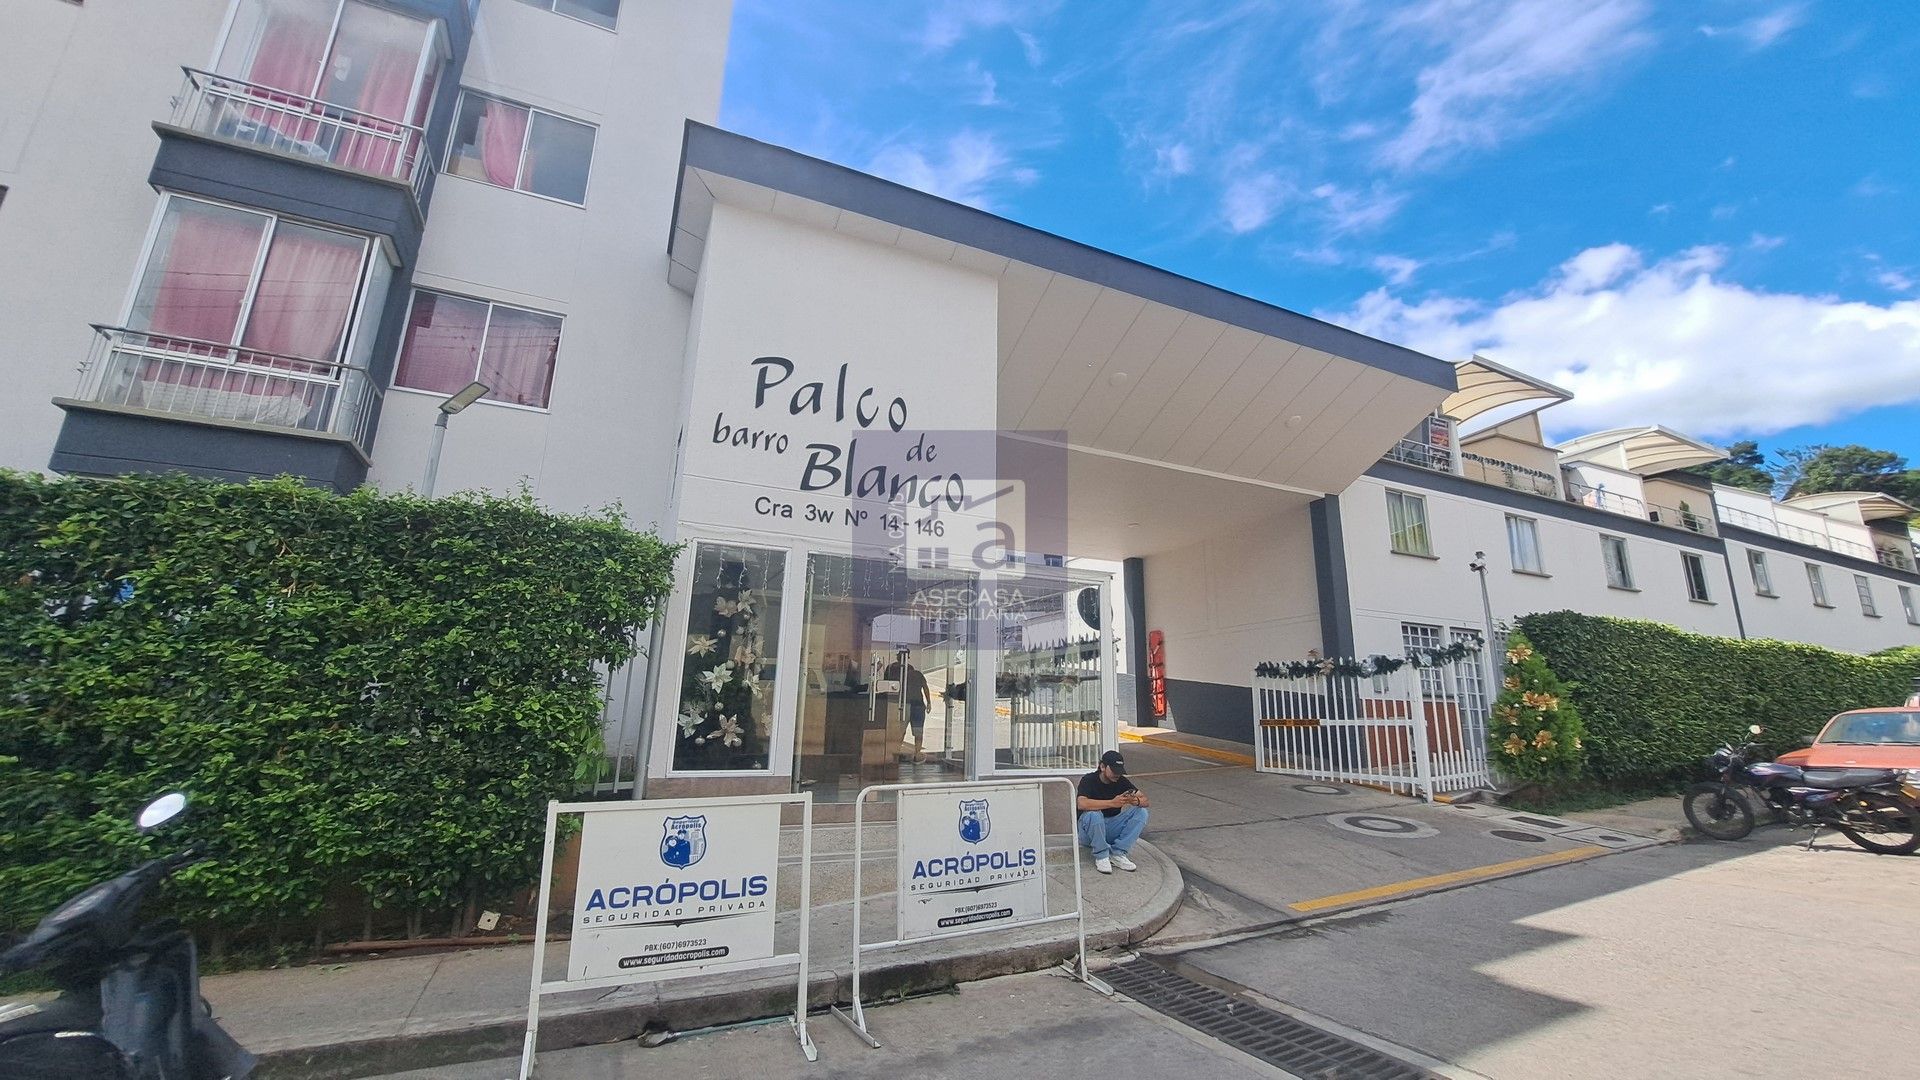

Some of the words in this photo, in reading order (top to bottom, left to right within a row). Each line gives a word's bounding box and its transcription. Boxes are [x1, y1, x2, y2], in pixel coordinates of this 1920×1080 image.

[751, 356, 907, 433] Palco
[712, 412, 789, 454] barro
[906, 433, 937, 463] de
[799, 439, 964, 512] Blanco
[754, 496, 793, 519] Cra
[804, 503, 833, 524] 3w
[912, 849, 1036, 879] ACRÓPOLIS
[585, 875, 768, 911] ACRÓPOLIS
[911, 877, 980, 891] SEGURIDAD
[990, 870, 1036, 881] PRIVADA
[583, 908, 683, 924] SEGURIDAD
[698, 900, 765, 914] PRIVADA
[623, 947, 726, 967] www.seguridadacropolis.com
